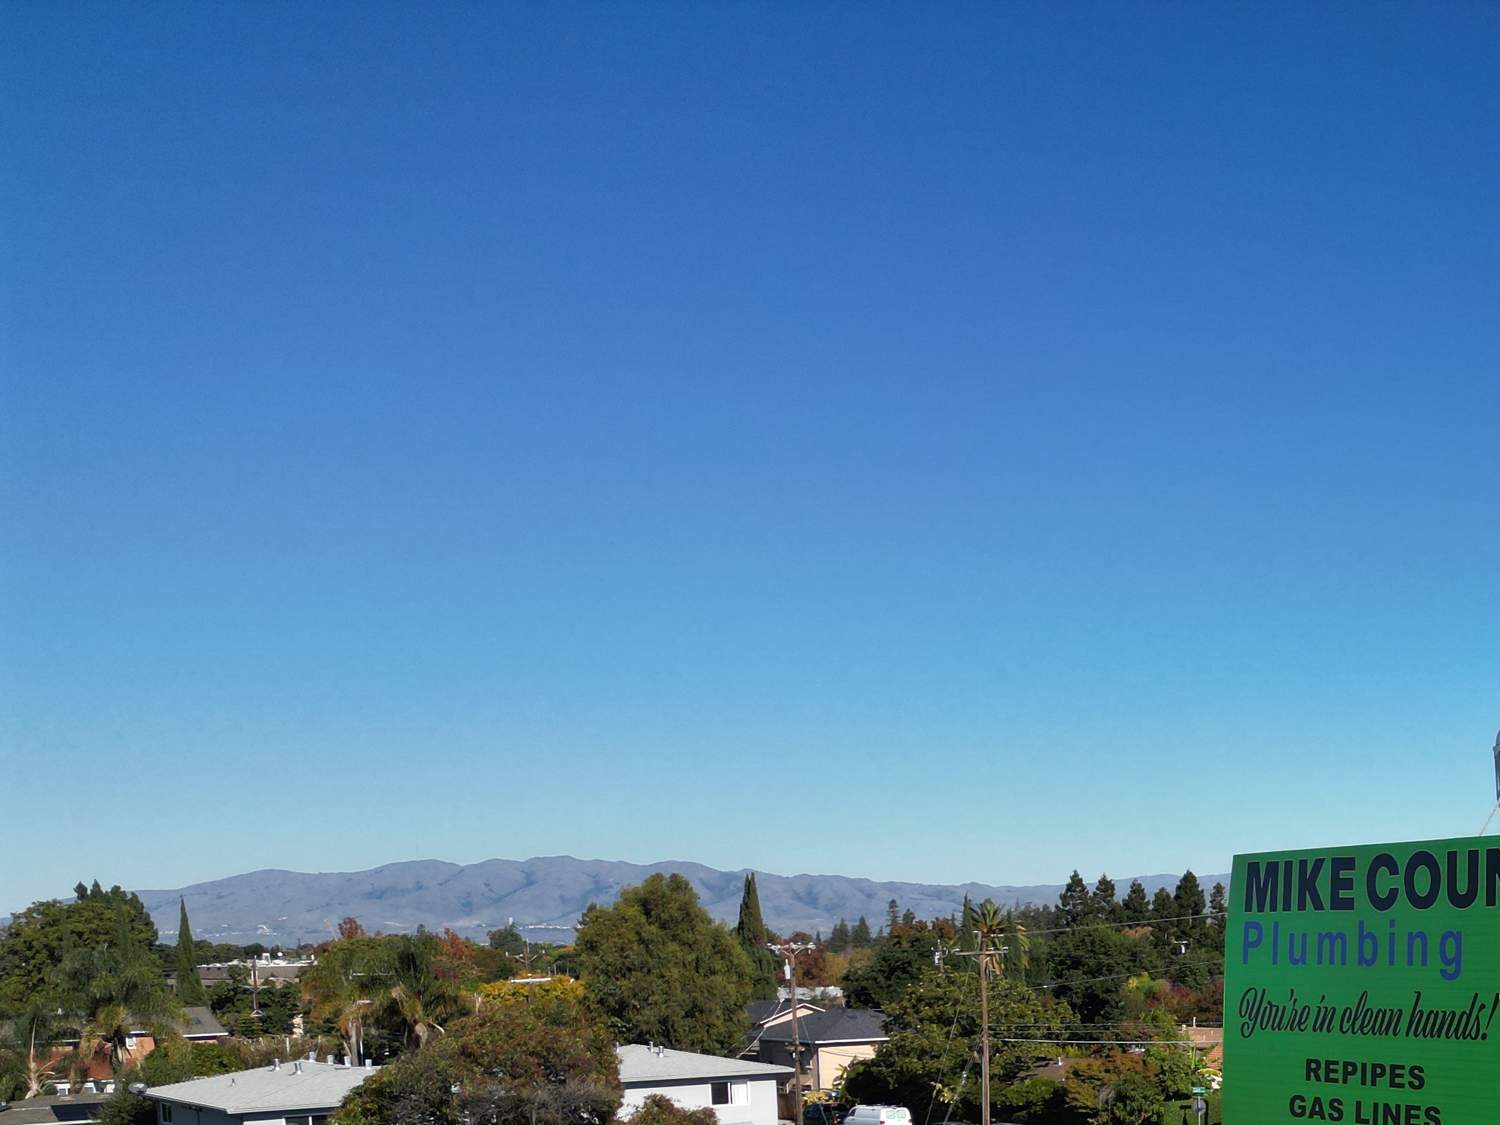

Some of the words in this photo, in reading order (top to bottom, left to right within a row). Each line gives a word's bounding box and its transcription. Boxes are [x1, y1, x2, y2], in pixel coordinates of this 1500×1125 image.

[1244, 856, 1356, 913] MIKE
[1242, 920, 1463, 981] Plumbing
[1239, 987, 1310, 1038] You're
[1312, 995, 1335, 1034] in
[1339, 990, 1404, 1036] clean
[1406, 991, 1500, 1041] hands!
[1305, 1058, 1426, 1090] REPIPES
[1289, 1095, 1344, 1122] GAS
